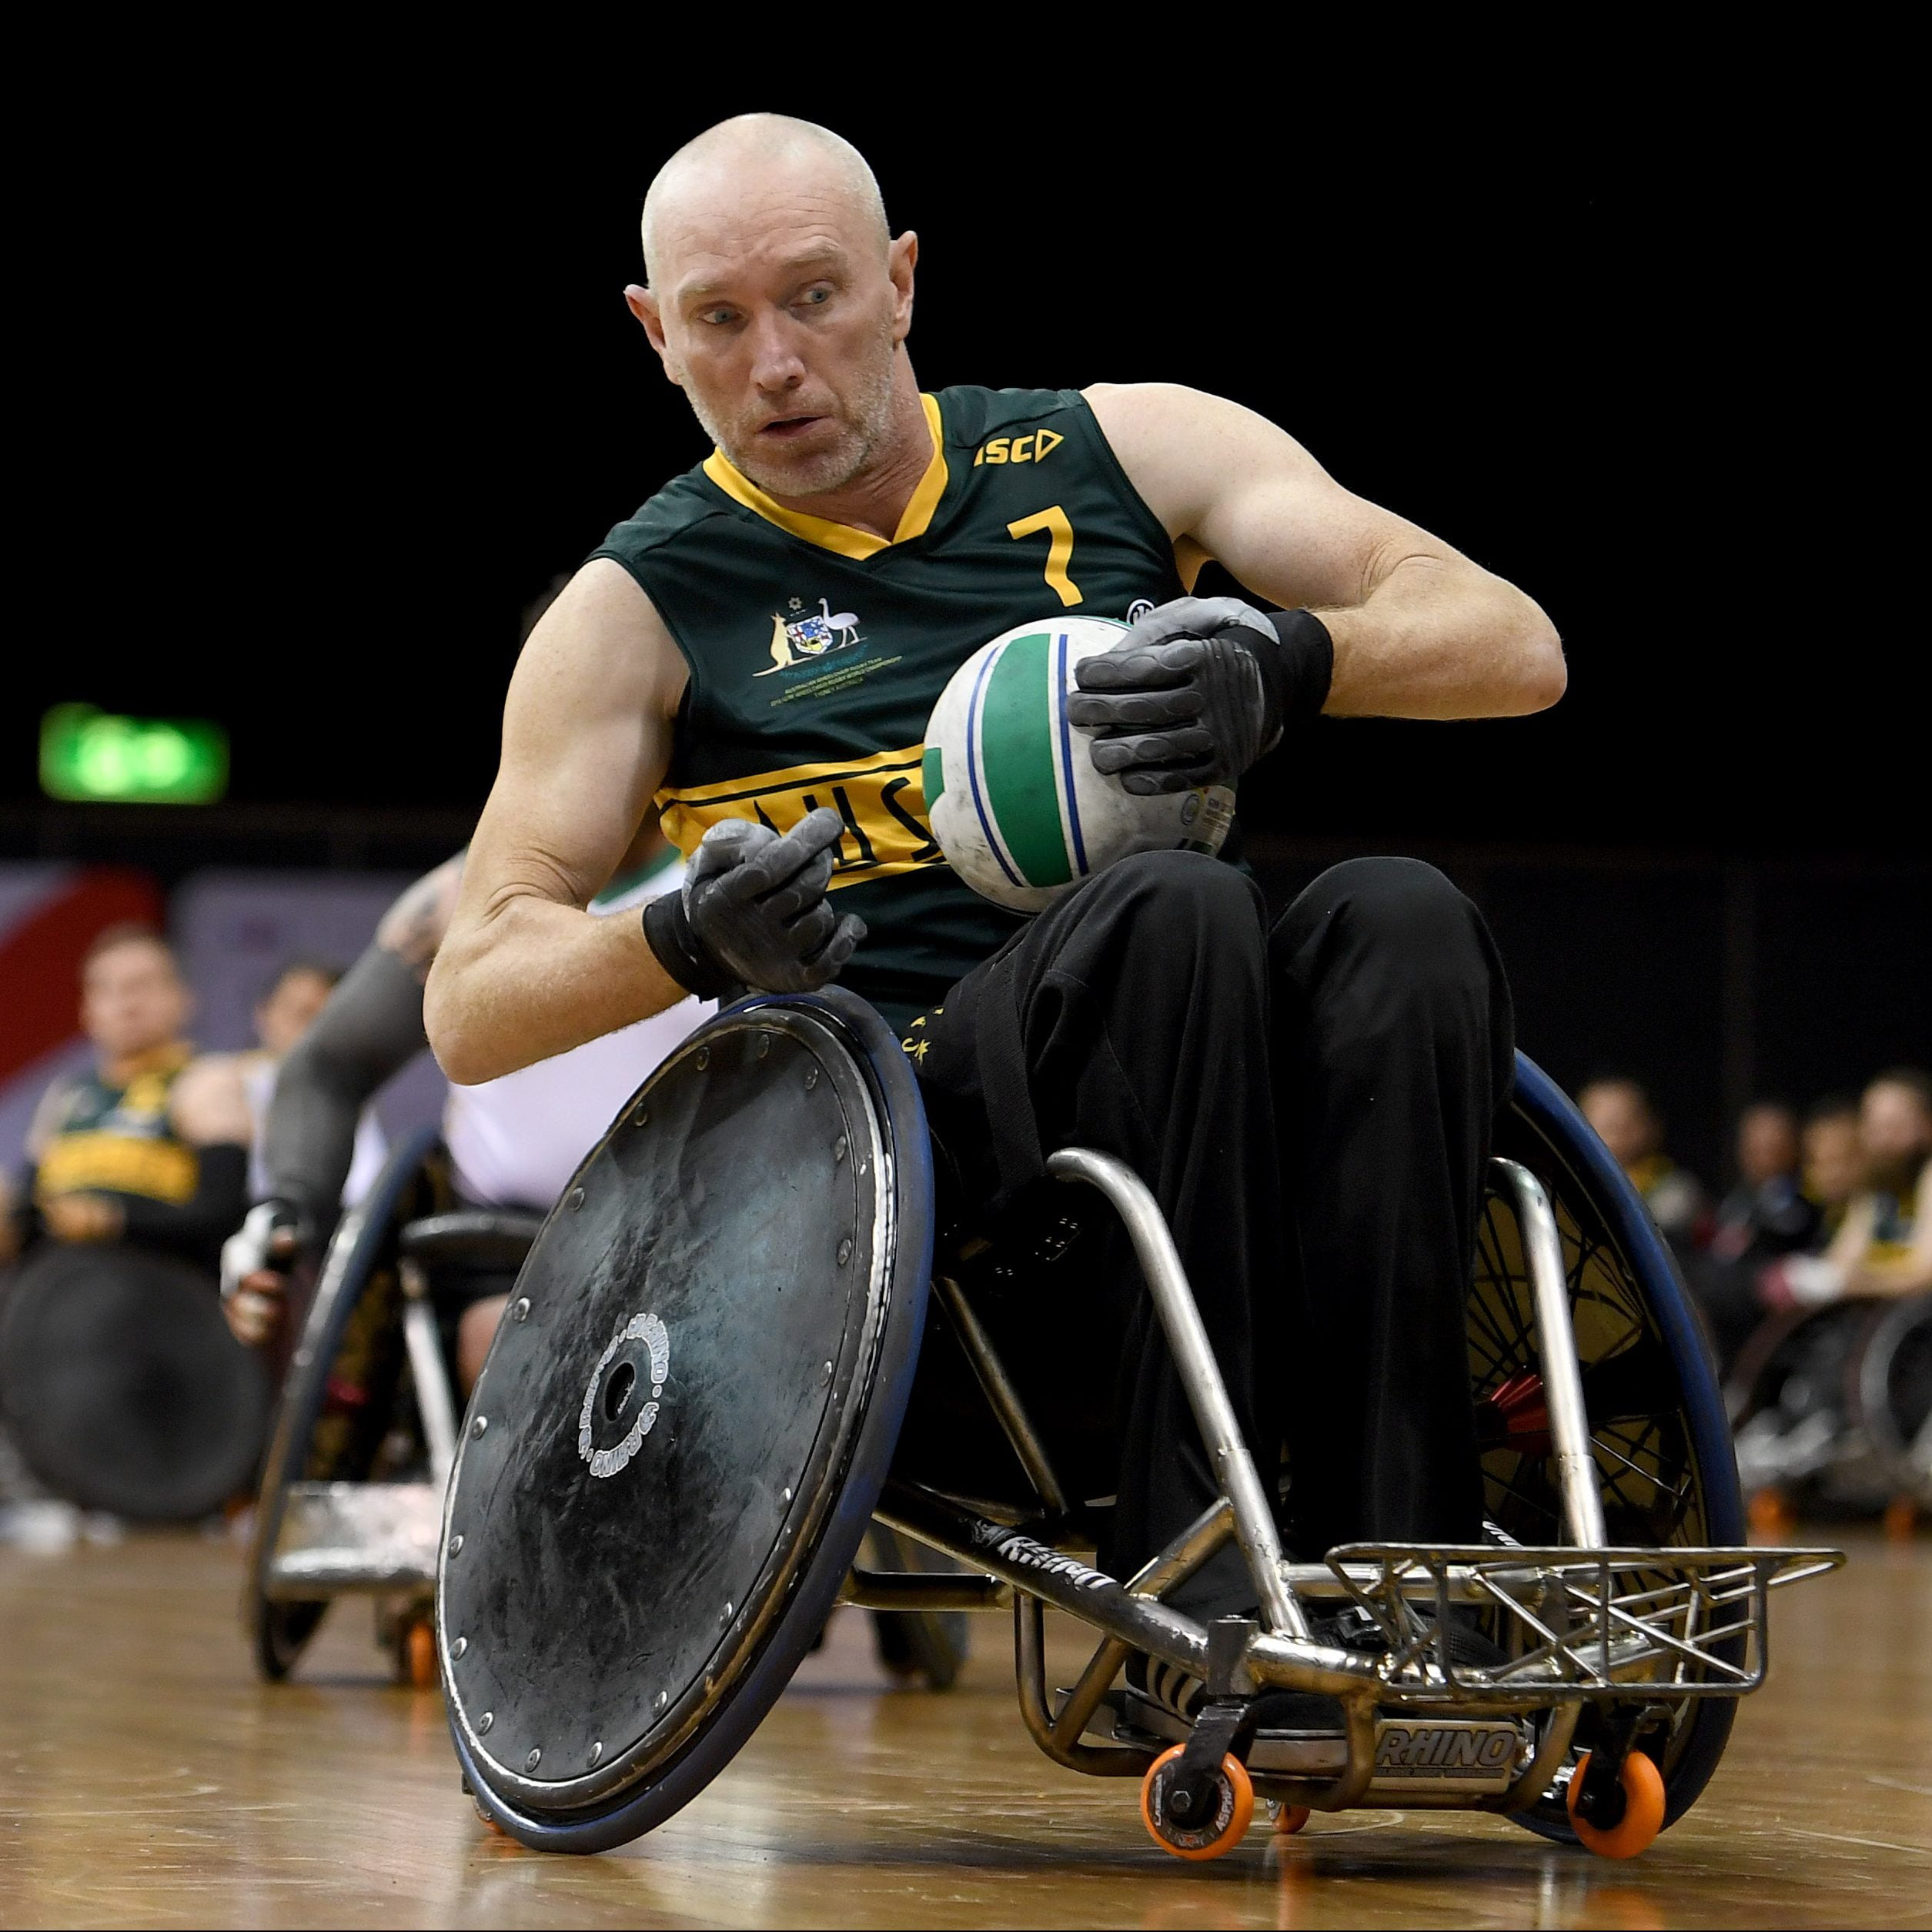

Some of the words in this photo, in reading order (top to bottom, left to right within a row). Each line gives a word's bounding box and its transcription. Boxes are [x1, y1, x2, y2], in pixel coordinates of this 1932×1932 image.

[974, 435, 1035, 467] ISC
[1006, 505, 1084, 607] 7
[590, 1422, 643, 1478] RHINO
[1375, 1729, 1516, 1767] RHINO
